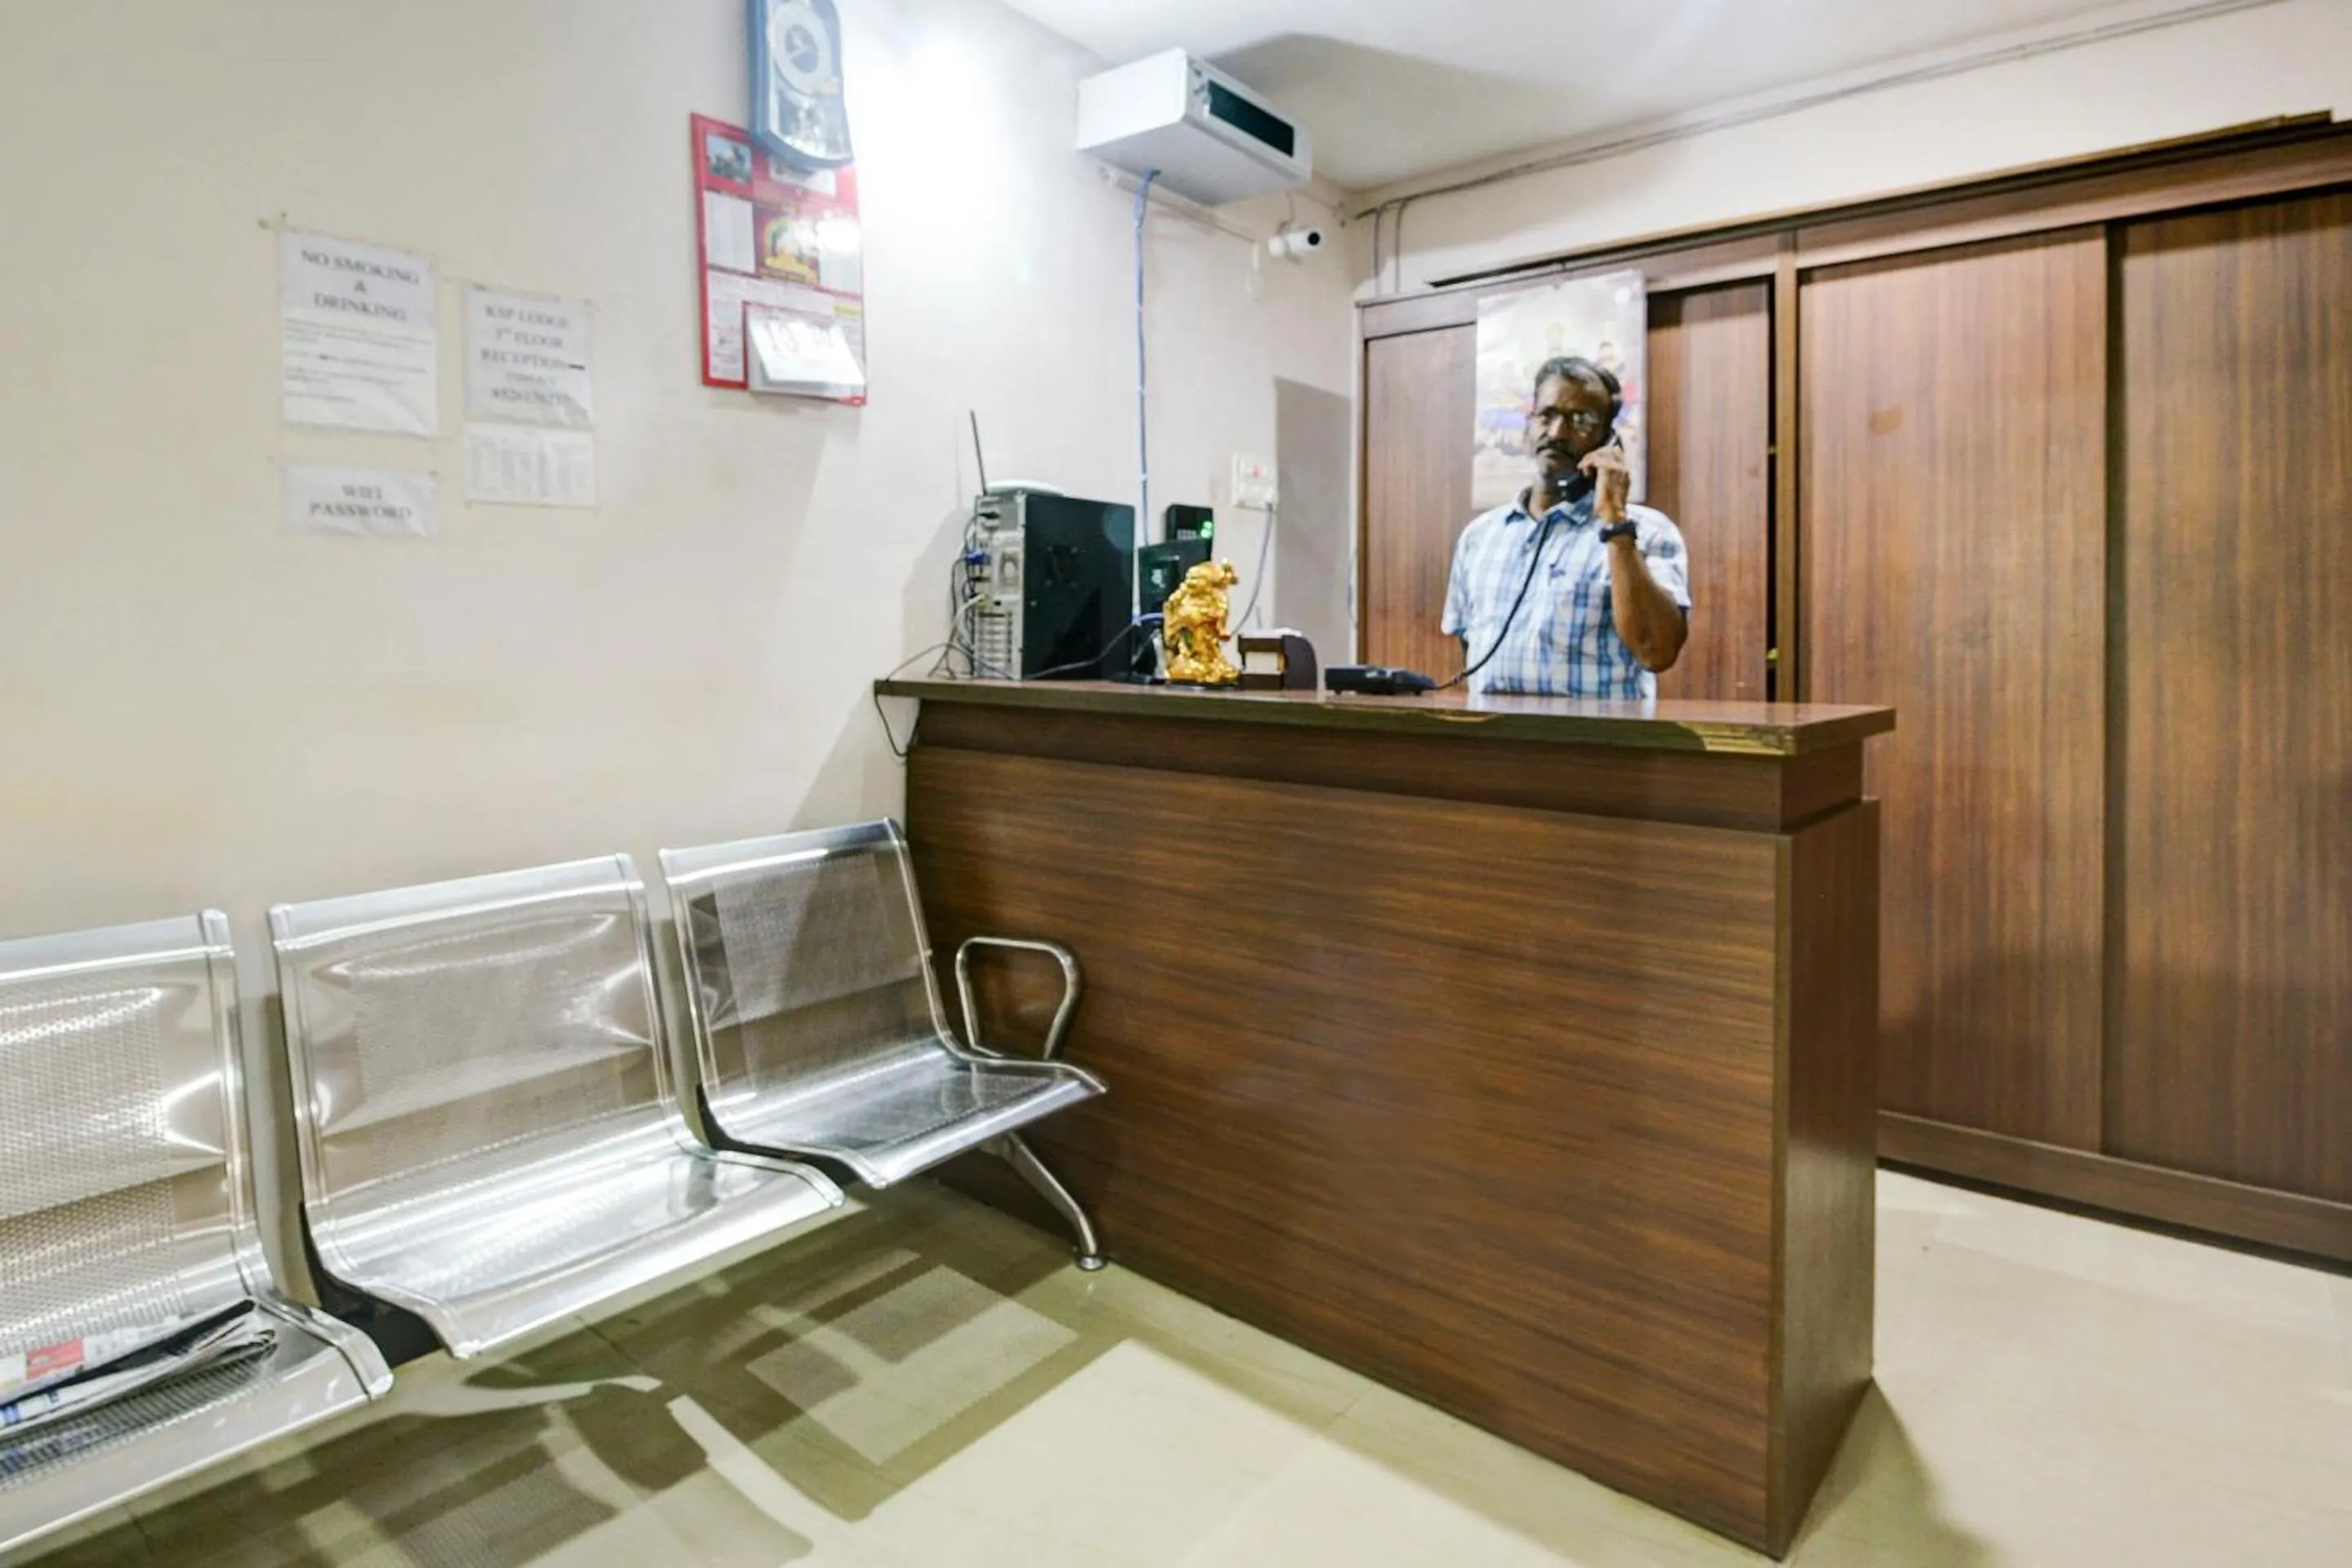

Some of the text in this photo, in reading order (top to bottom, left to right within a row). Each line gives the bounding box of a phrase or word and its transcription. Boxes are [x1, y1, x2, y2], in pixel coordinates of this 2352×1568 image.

[301, 250, 420, 286] NO SMOKING
[314, 293, 407, 323] DRINKING
[310, 501, 413, 519] PASSWORD
